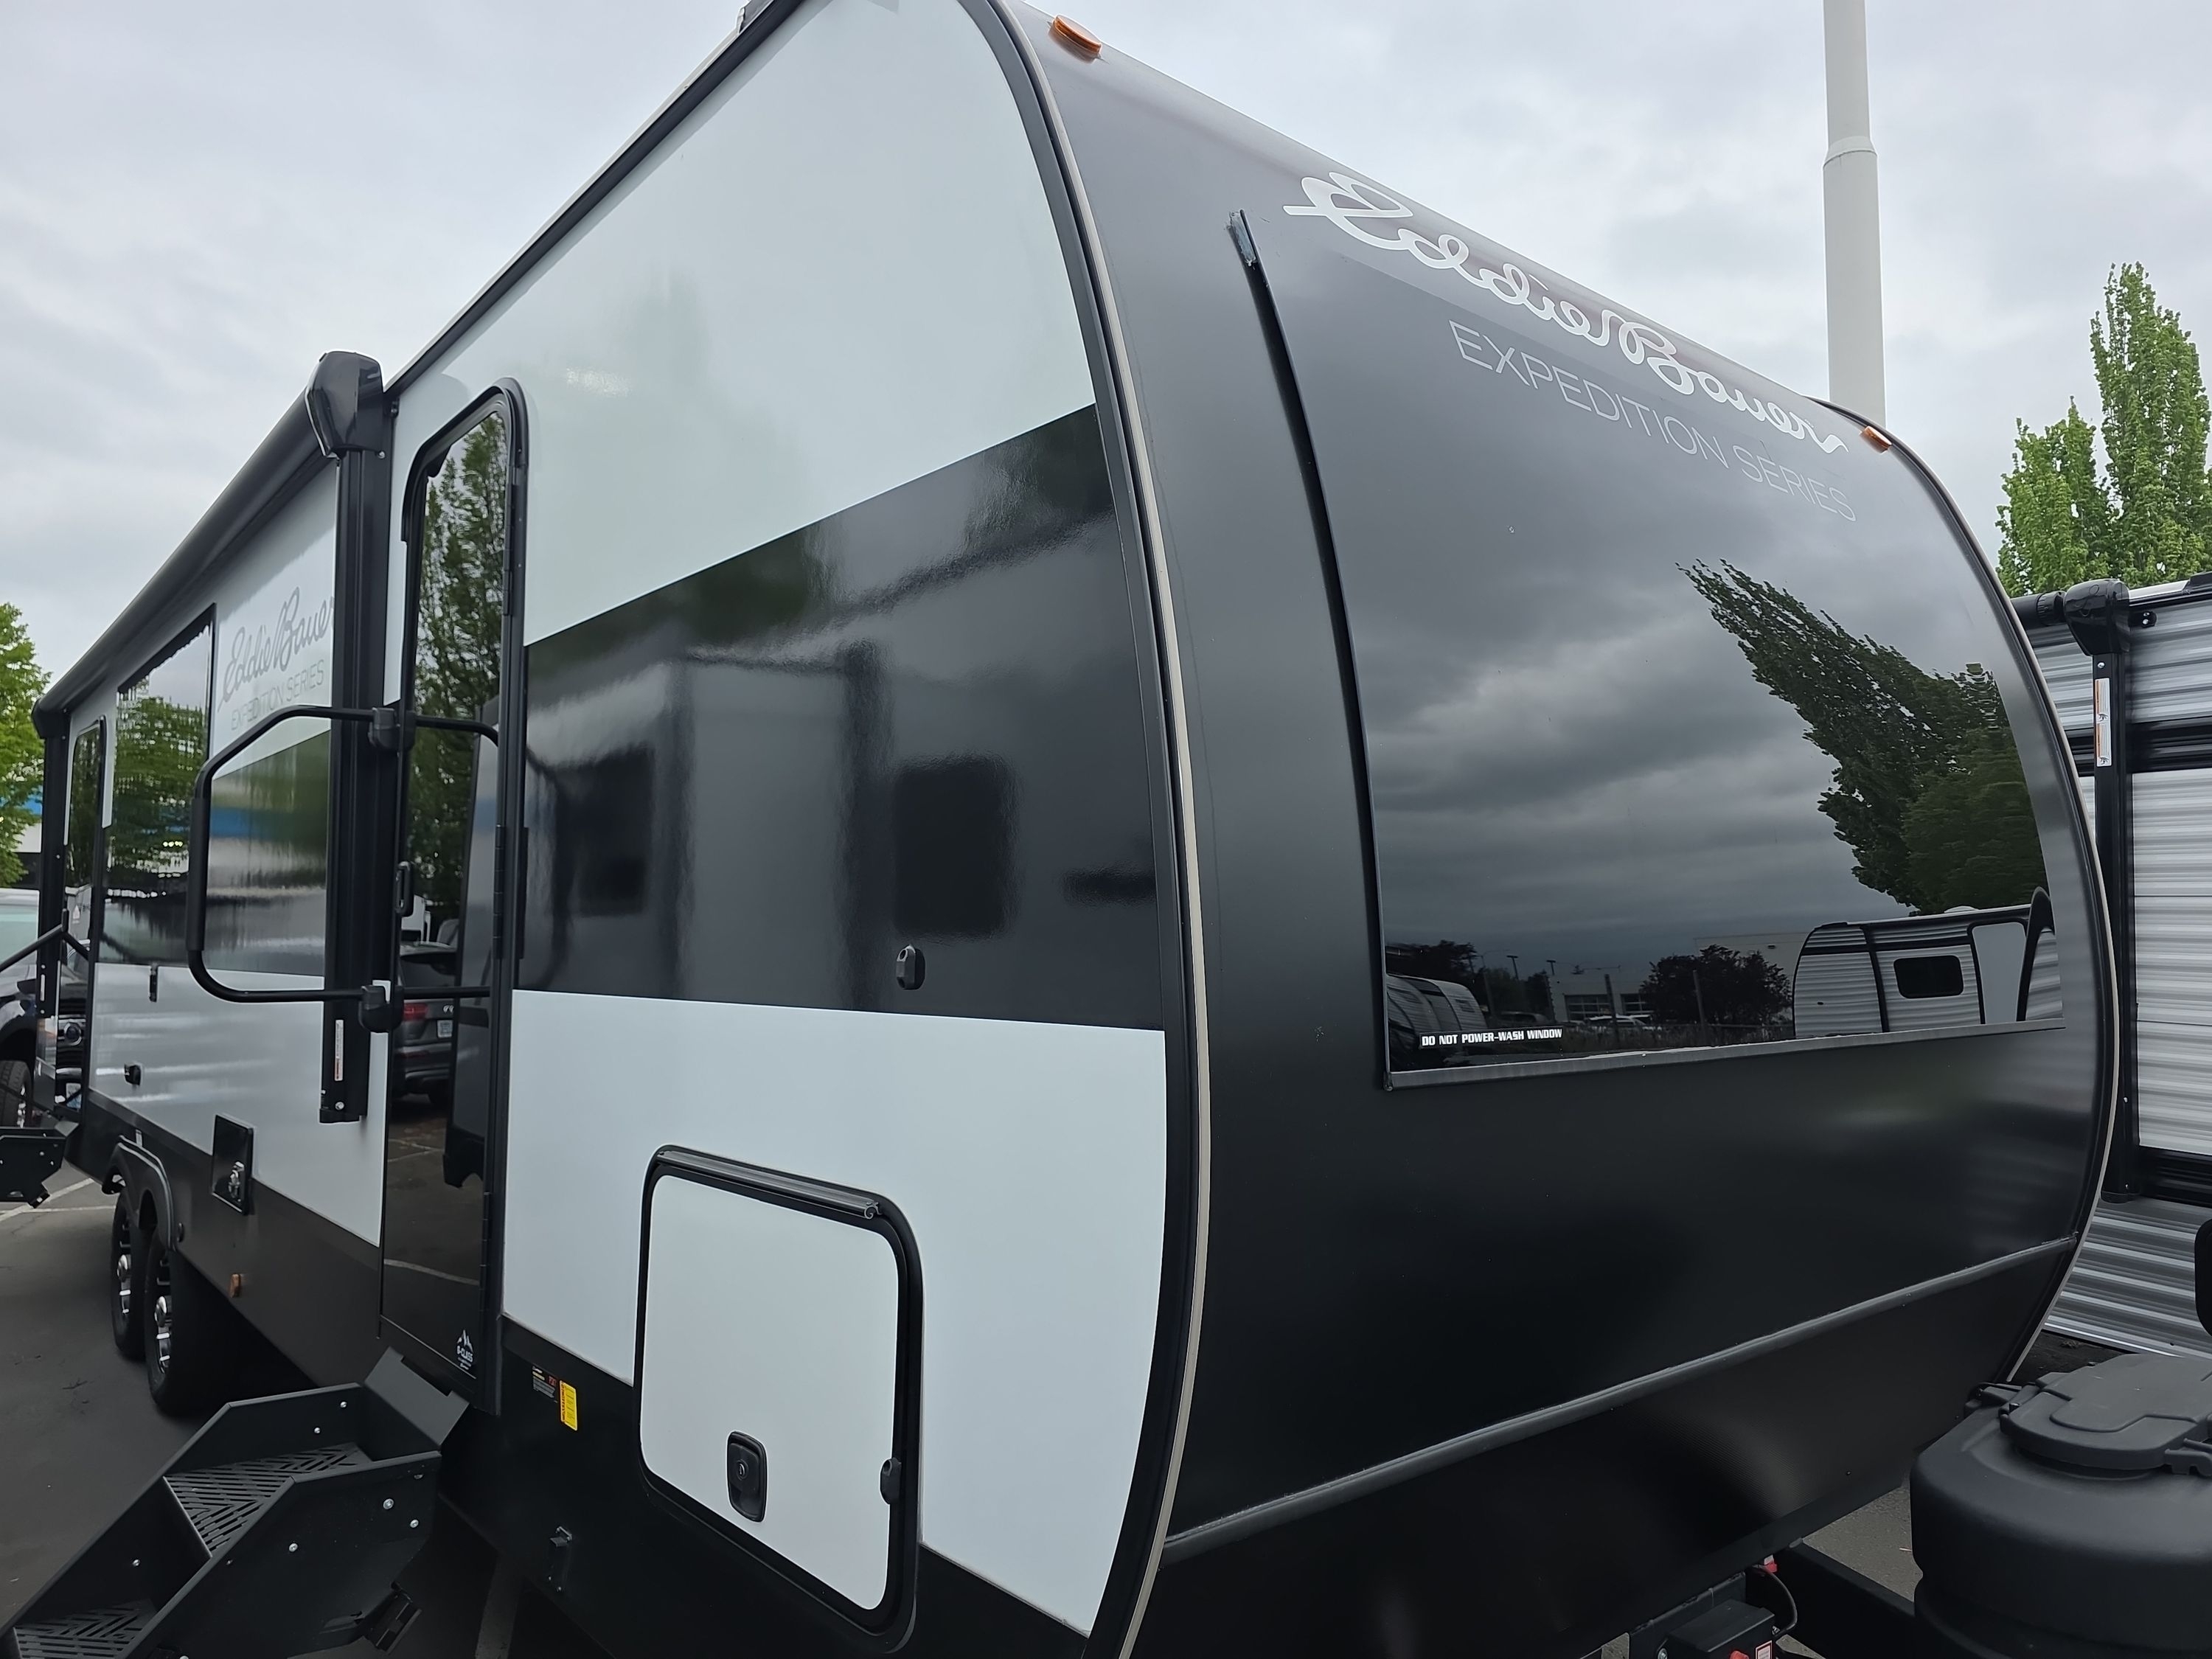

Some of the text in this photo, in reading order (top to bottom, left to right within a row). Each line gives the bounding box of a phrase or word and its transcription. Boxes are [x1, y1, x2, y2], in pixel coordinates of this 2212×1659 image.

[1282, 171, 1849, 454] Eddie Bauer
[1449, 319, 1857, 522] EXPEDITION SERIES
[218, 625, 274, 713] Eddie
[285, 659, 324, 702] SERIES
[1422, 1029, 1562, 1046] DO NOT POWER-WASH WINDOW
